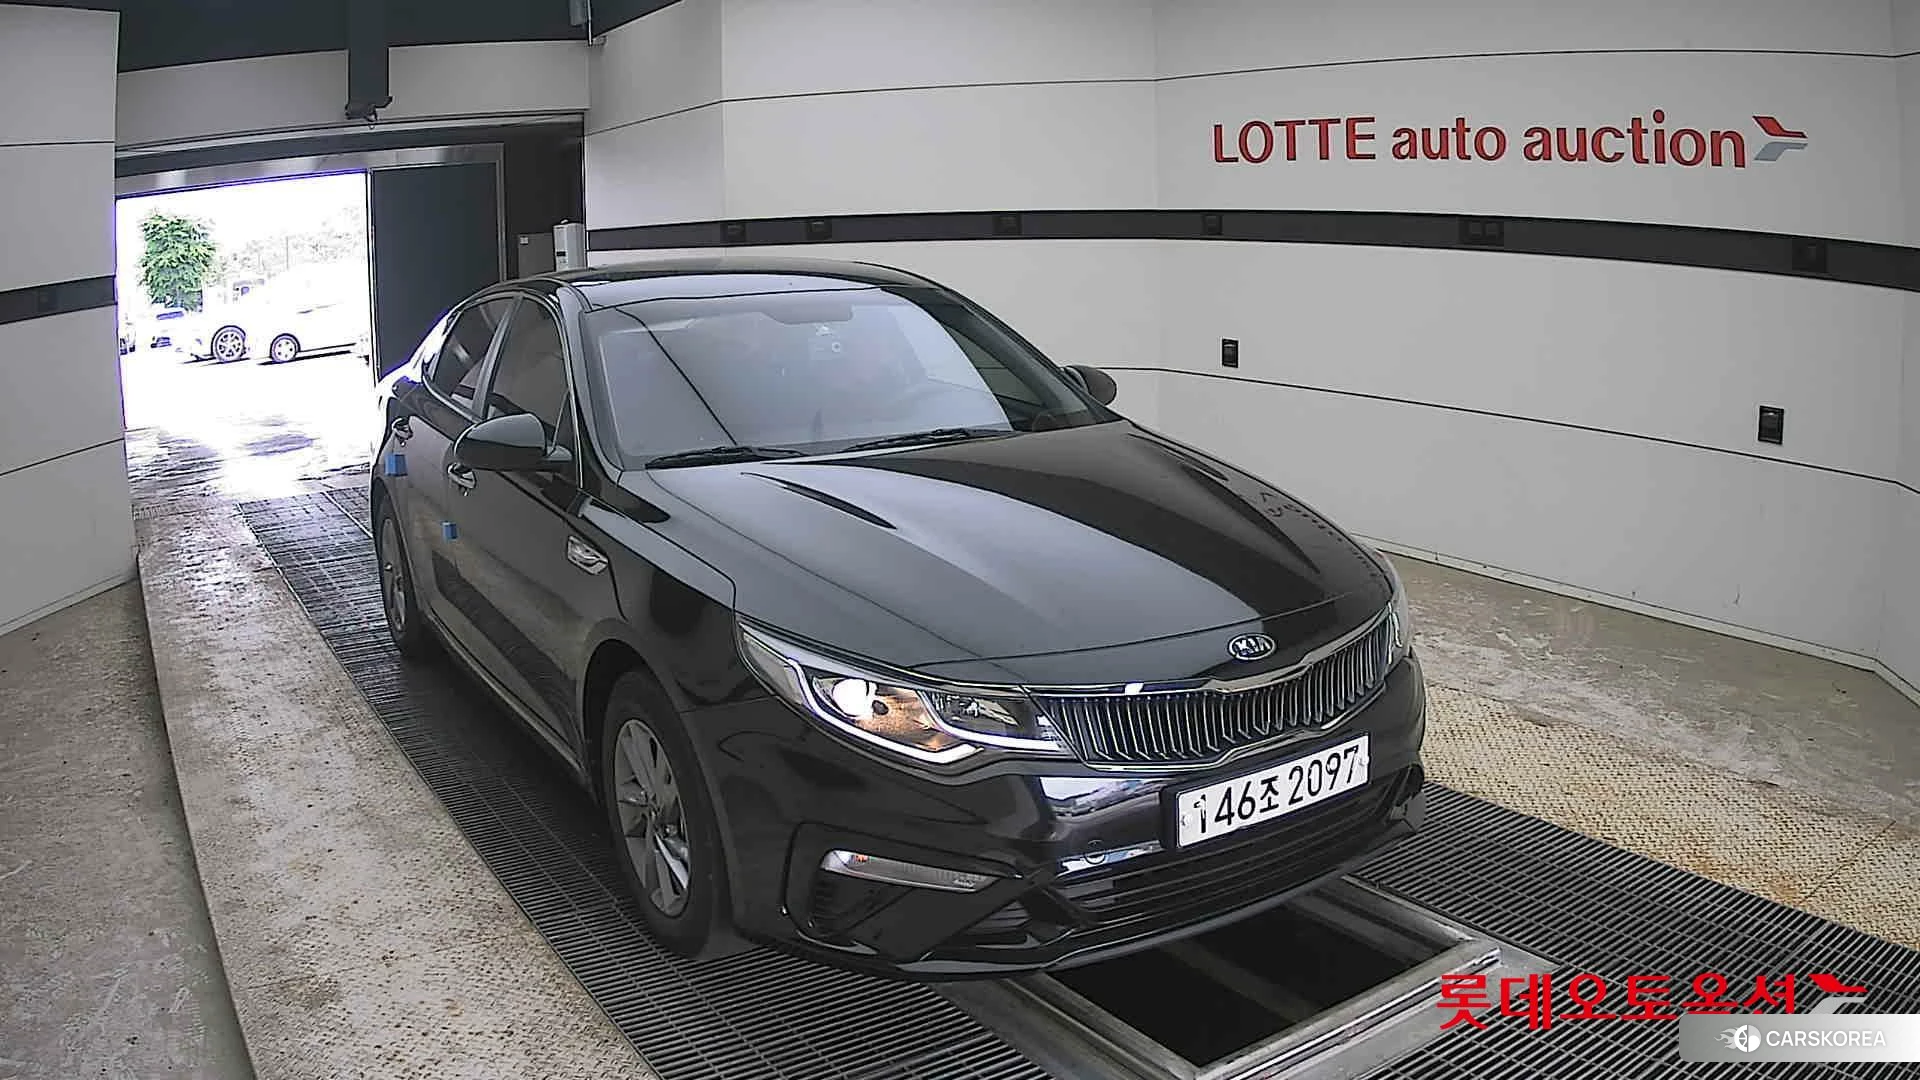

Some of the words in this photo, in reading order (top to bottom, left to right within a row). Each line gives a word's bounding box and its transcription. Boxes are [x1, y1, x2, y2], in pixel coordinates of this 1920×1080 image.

[1212, 115, 1377, 164] LOTTE
[1391, 117, 1508, 162] auto
[1522, 110, 1747, 169] auction
